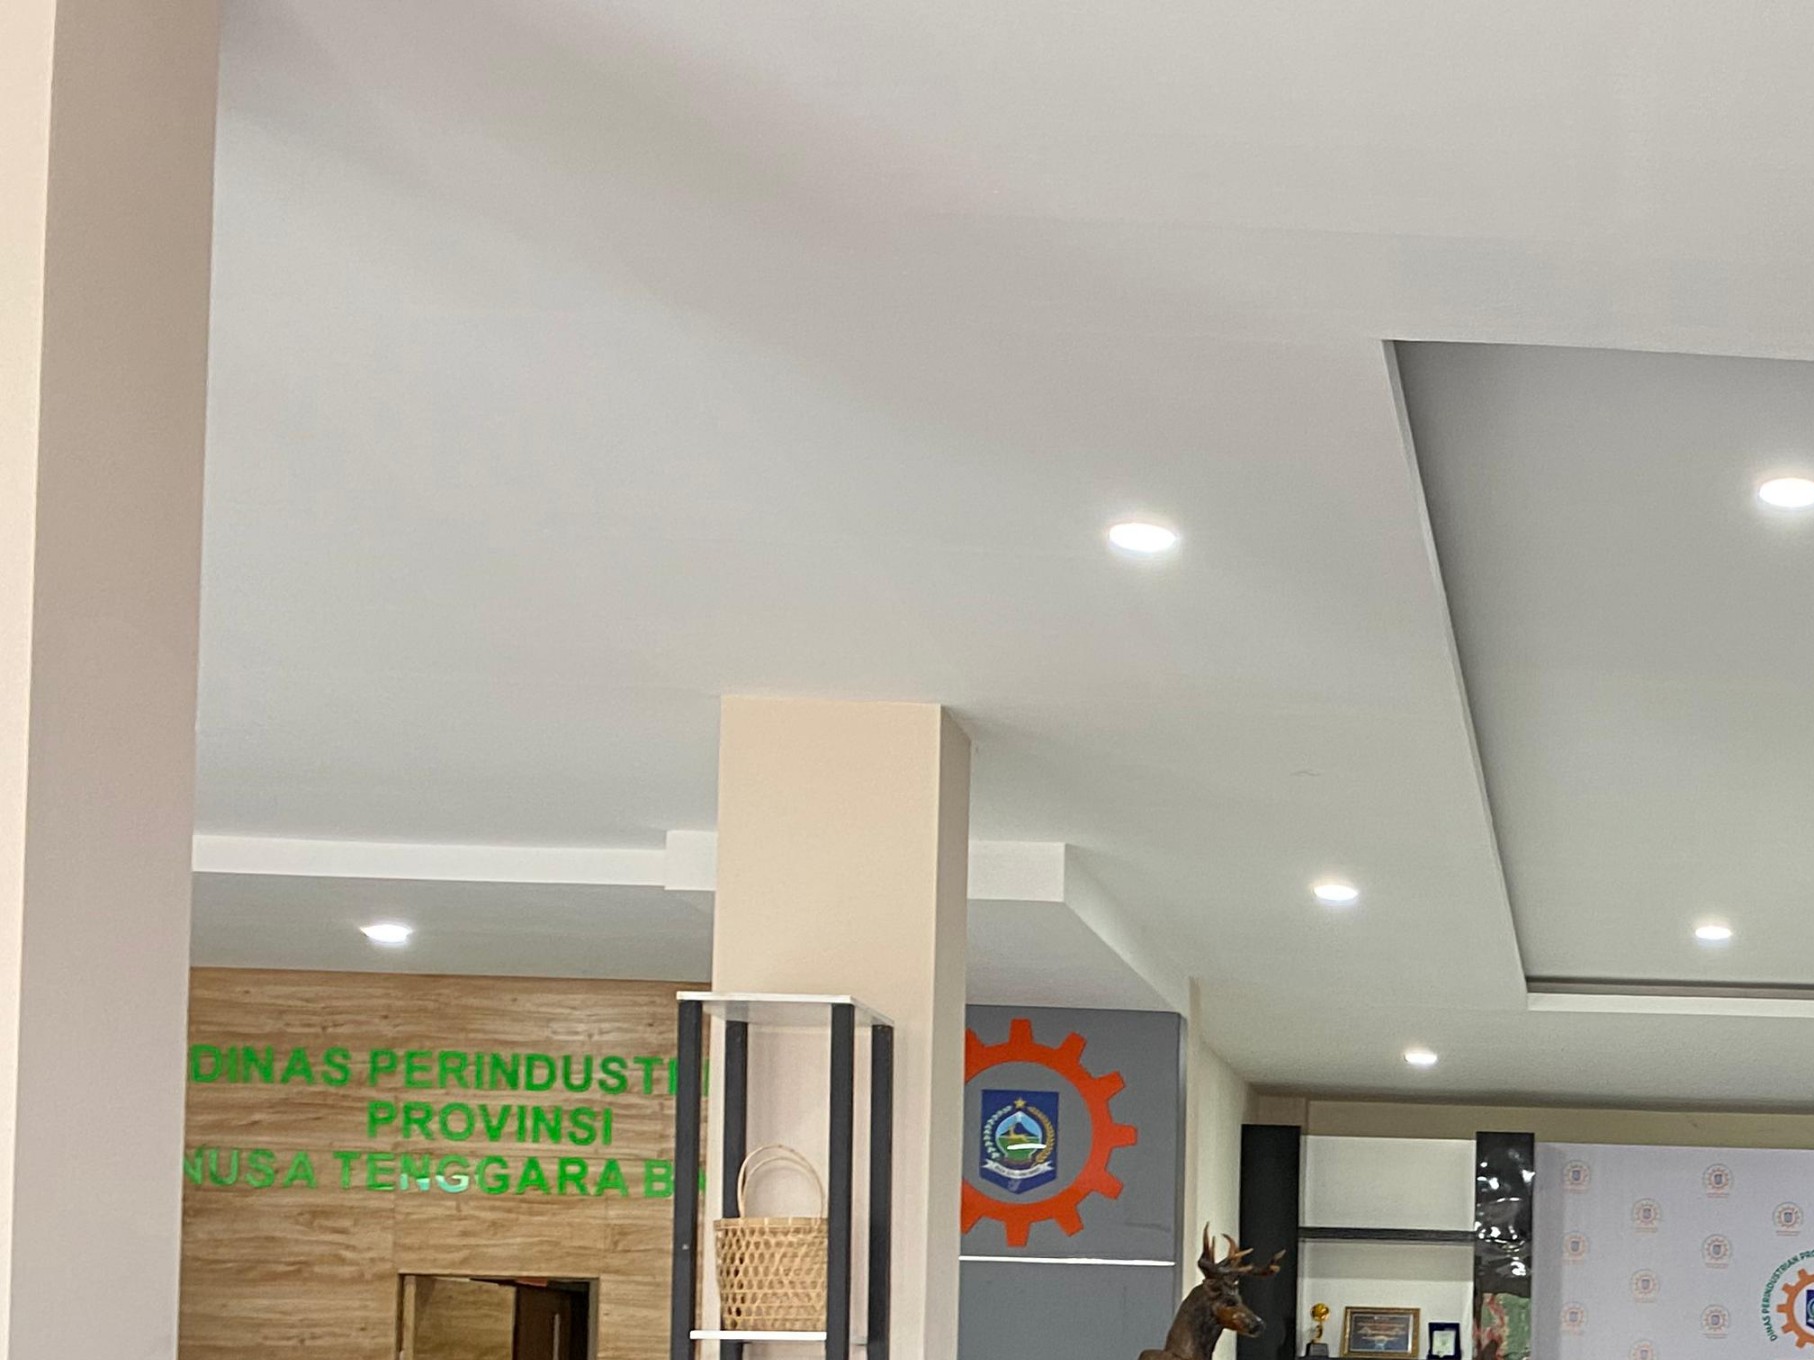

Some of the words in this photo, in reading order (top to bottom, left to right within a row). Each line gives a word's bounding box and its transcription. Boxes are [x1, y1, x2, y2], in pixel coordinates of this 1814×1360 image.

[190, 1044, 353, 1087] DINAS
[367, 1101, 614, 1146] PROVINSI
[333, 1151, 630, 1198] TENGGARA
